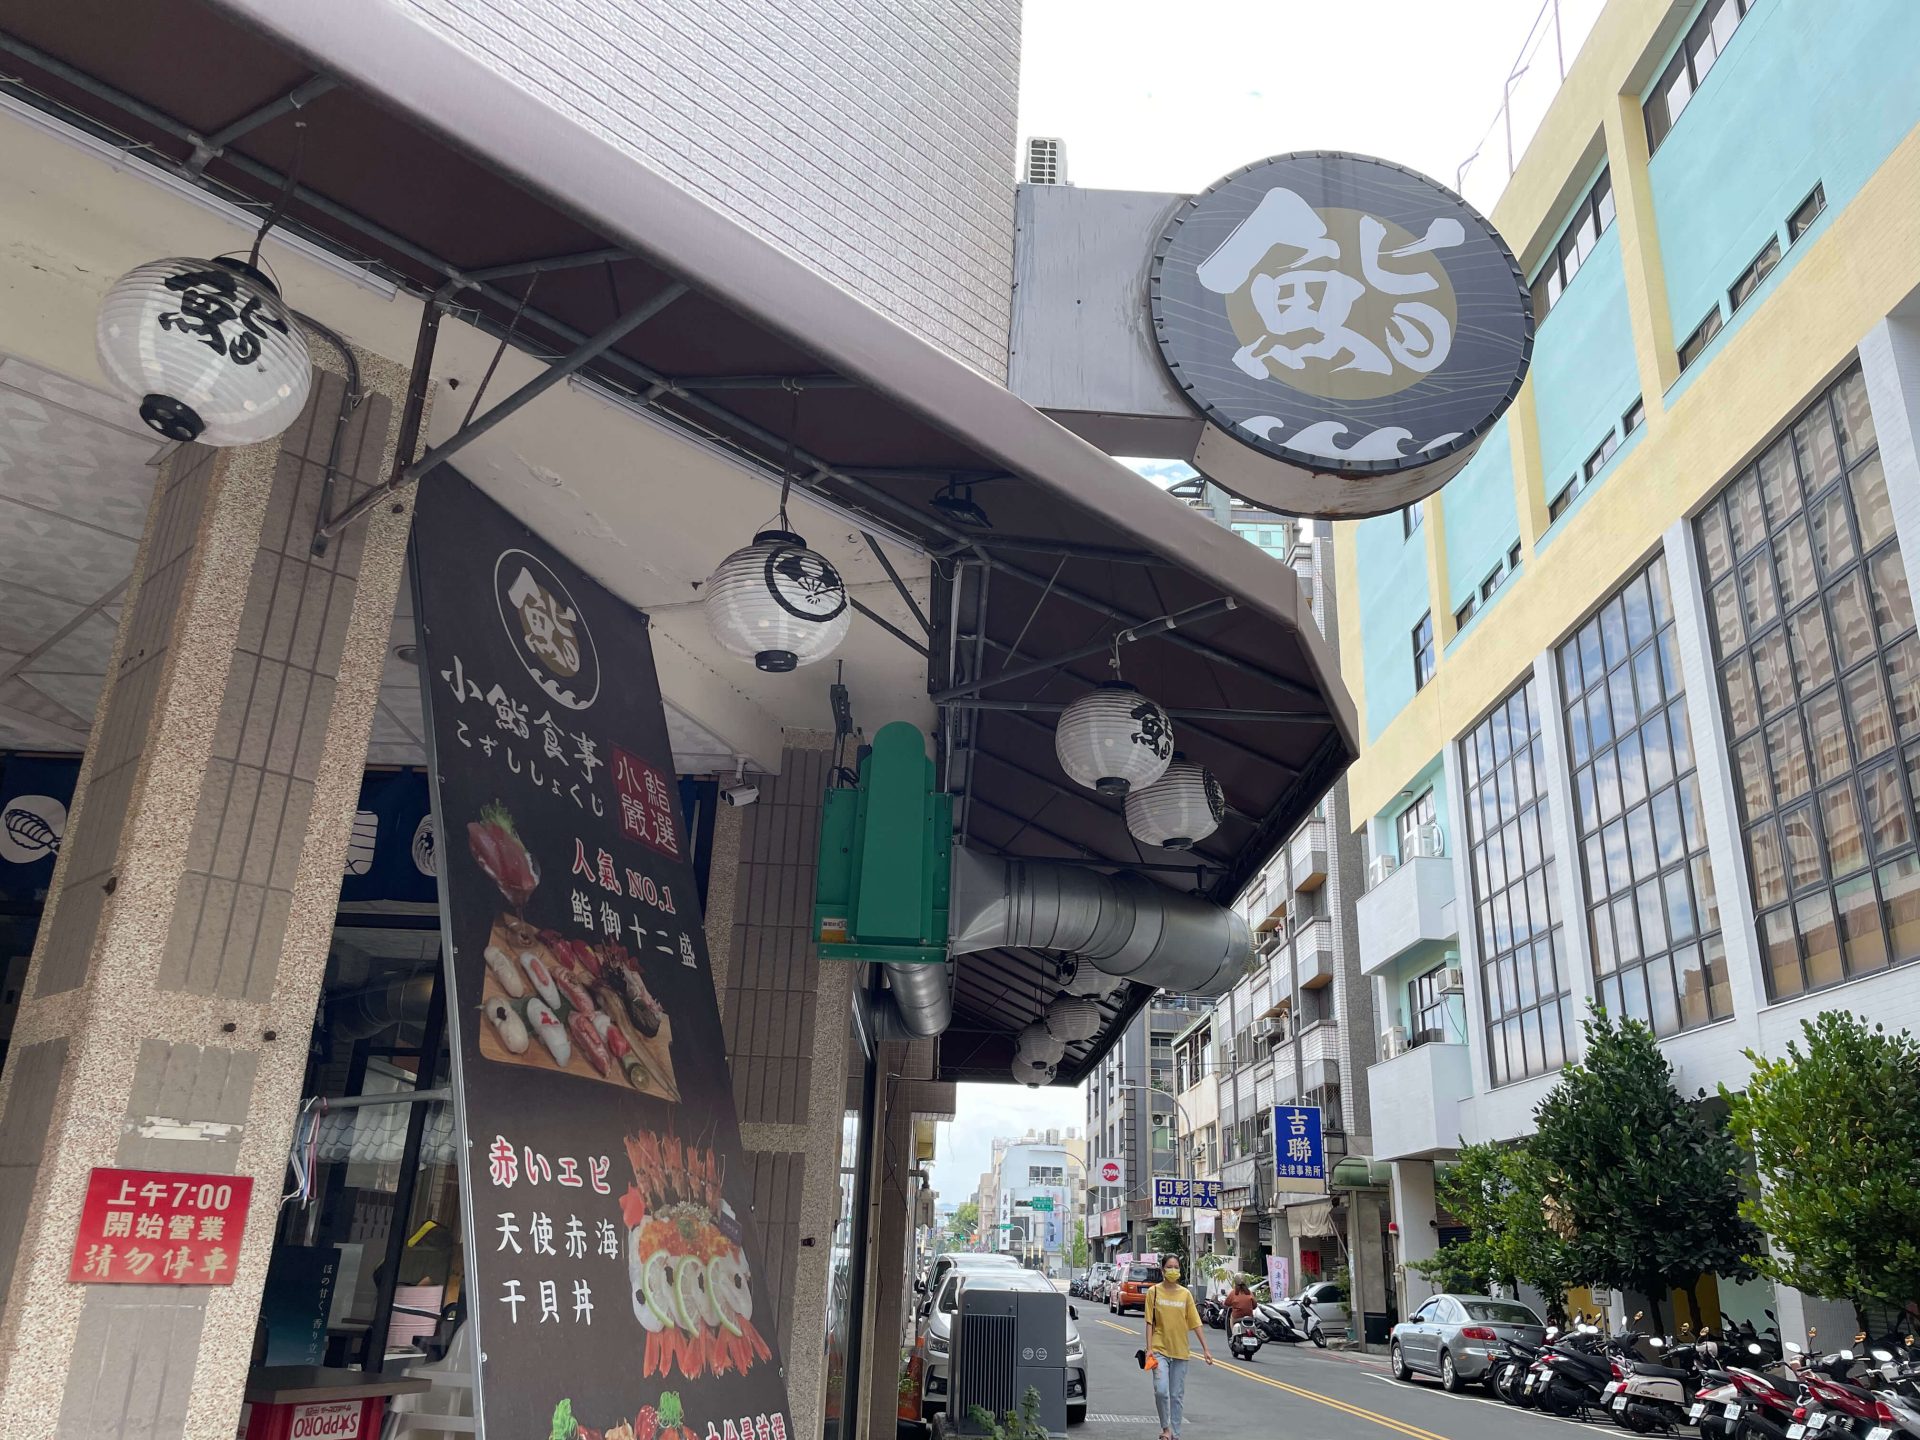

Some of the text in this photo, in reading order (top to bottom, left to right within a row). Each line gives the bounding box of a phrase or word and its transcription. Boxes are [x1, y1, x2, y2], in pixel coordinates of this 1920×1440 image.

[572, 837, 676, 915] 人氣 NO.1
[570, 888, 697, 970] 鮨御十二盛
[1287, 1109, 1312, 1163] 吉聯
[1101, 1168, 1120, 1178] SYM
[1279, 1164, 1321, 1177] 法律事務所
[107, 1180, 232, 1210] 上午7:00
[102, 1211, 226, 1241] 開始營業
[496, 1211, 619, 1260] 天使赤海
[82, 1244, 228, 1280] 請勿停車
